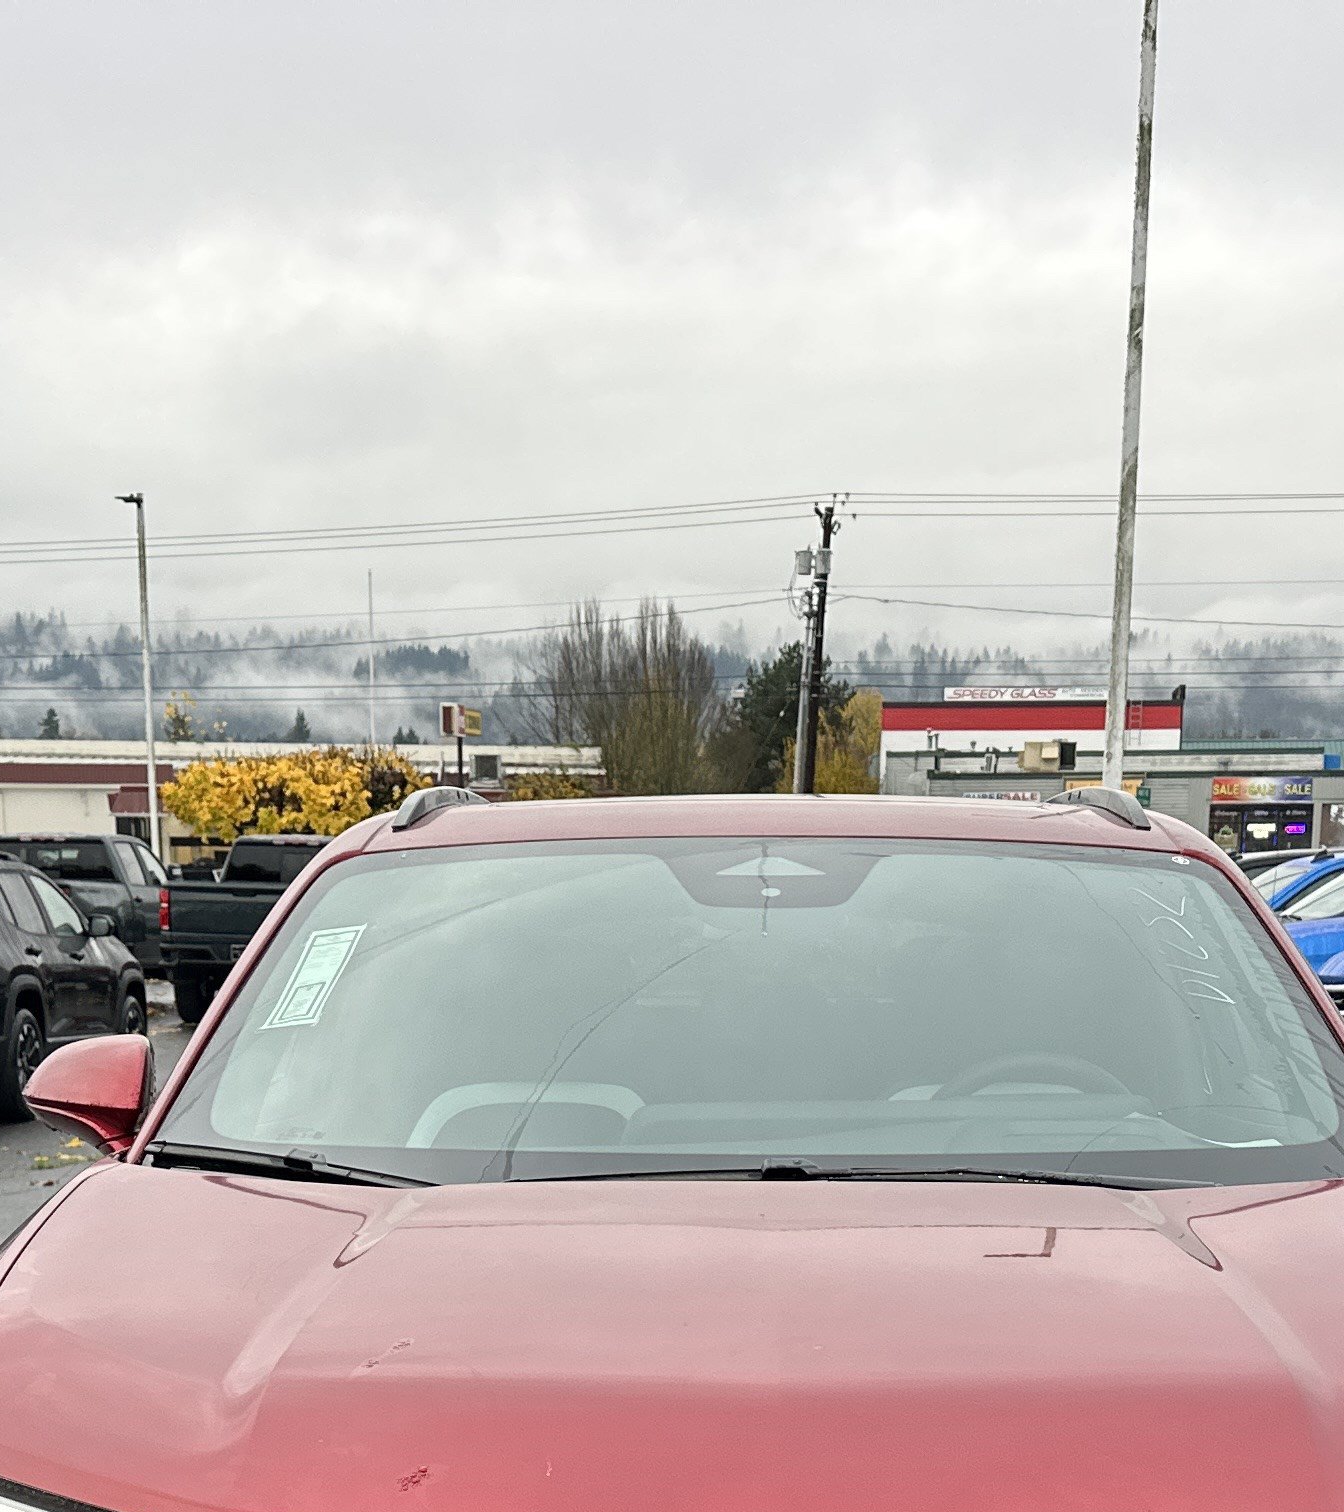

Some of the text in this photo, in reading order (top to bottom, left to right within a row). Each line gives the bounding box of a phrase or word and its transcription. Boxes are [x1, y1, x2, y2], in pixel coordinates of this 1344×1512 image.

[948, 689, 1007, 699] SPEEDY
[1010, 689, 1056, 699] GLASS
[1213, 784, 1240, 795] SALE
[1285, 783, 1312, 795] SALE
